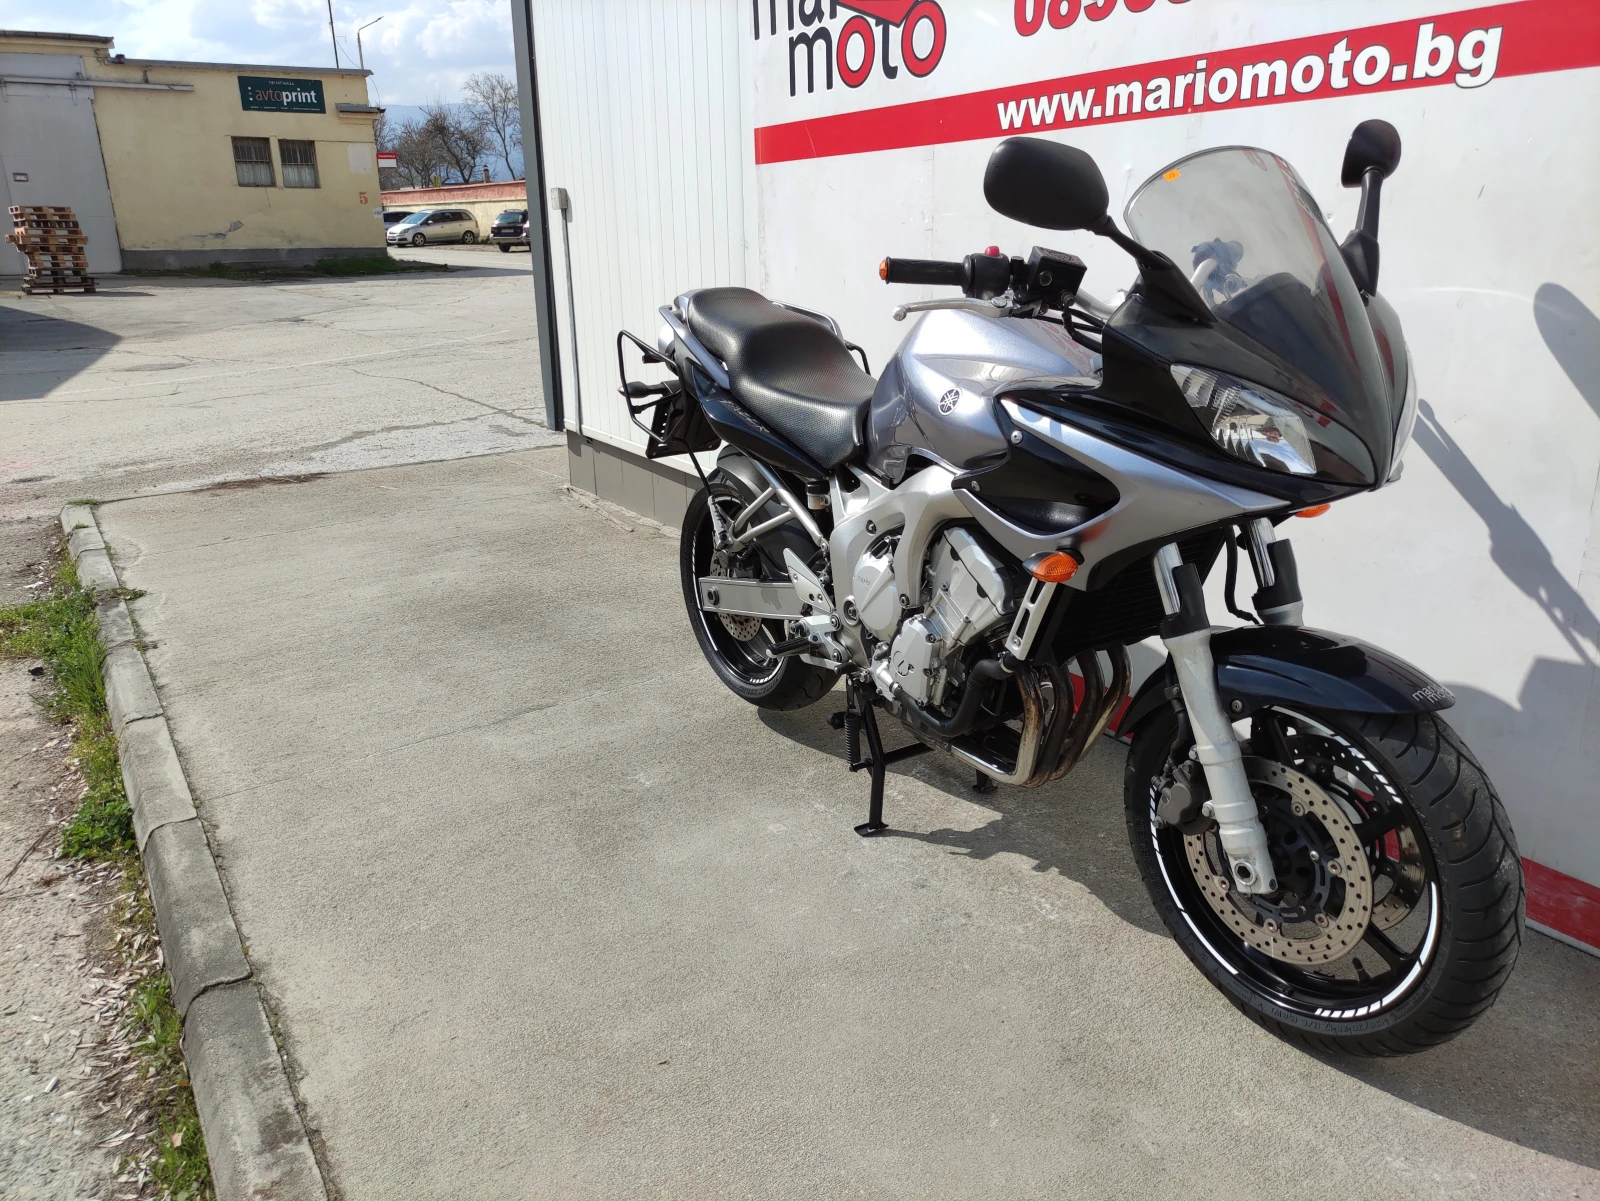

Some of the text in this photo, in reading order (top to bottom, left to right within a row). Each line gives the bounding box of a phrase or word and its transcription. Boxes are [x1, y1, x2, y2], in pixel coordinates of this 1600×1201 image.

[788, 0, 947, 97] moto
[997, 22, 1504, 131] www.mariomoto.bg
[255, 87, 318, 106] avtoprint
[359, 191, 369, 205] 5
